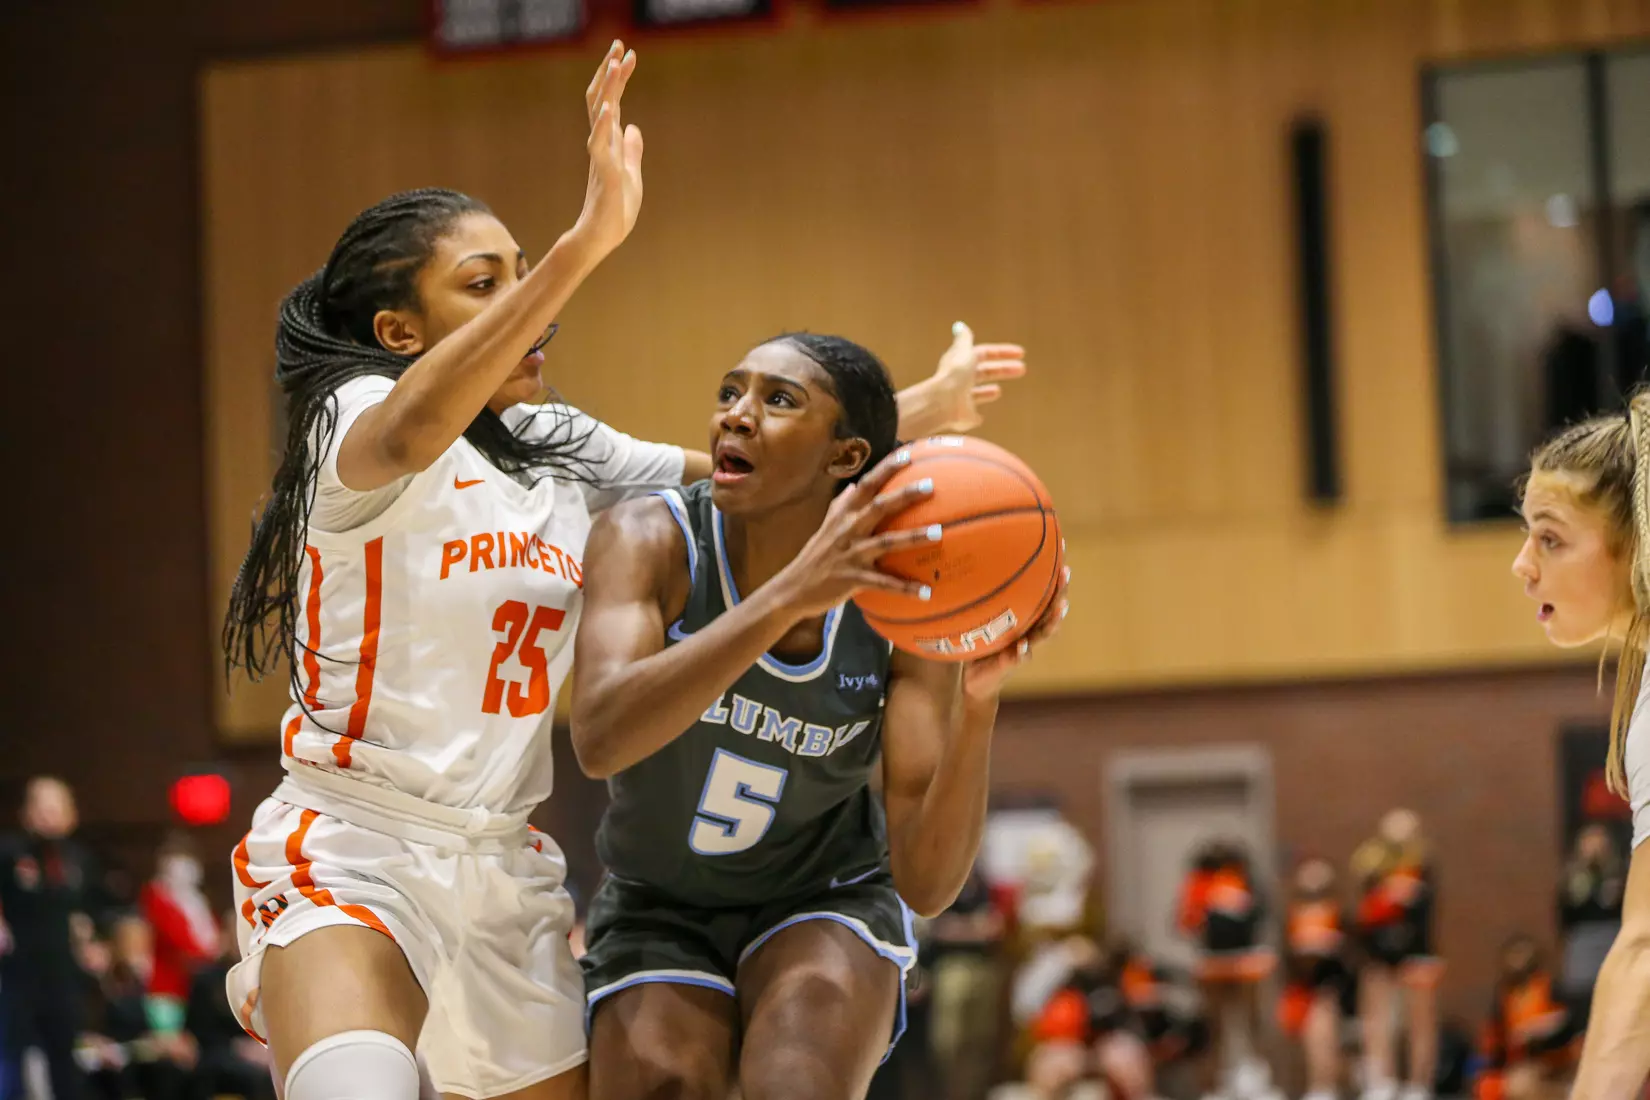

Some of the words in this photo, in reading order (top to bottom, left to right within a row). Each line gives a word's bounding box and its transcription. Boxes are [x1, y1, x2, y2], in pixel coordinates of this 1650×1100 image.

[440, 531, 584, 589] PRINCETO
[481, 599, 567, 719] 25
[839, 673, 865, 691] Ivy
[688, 746, 789, 856] 5
